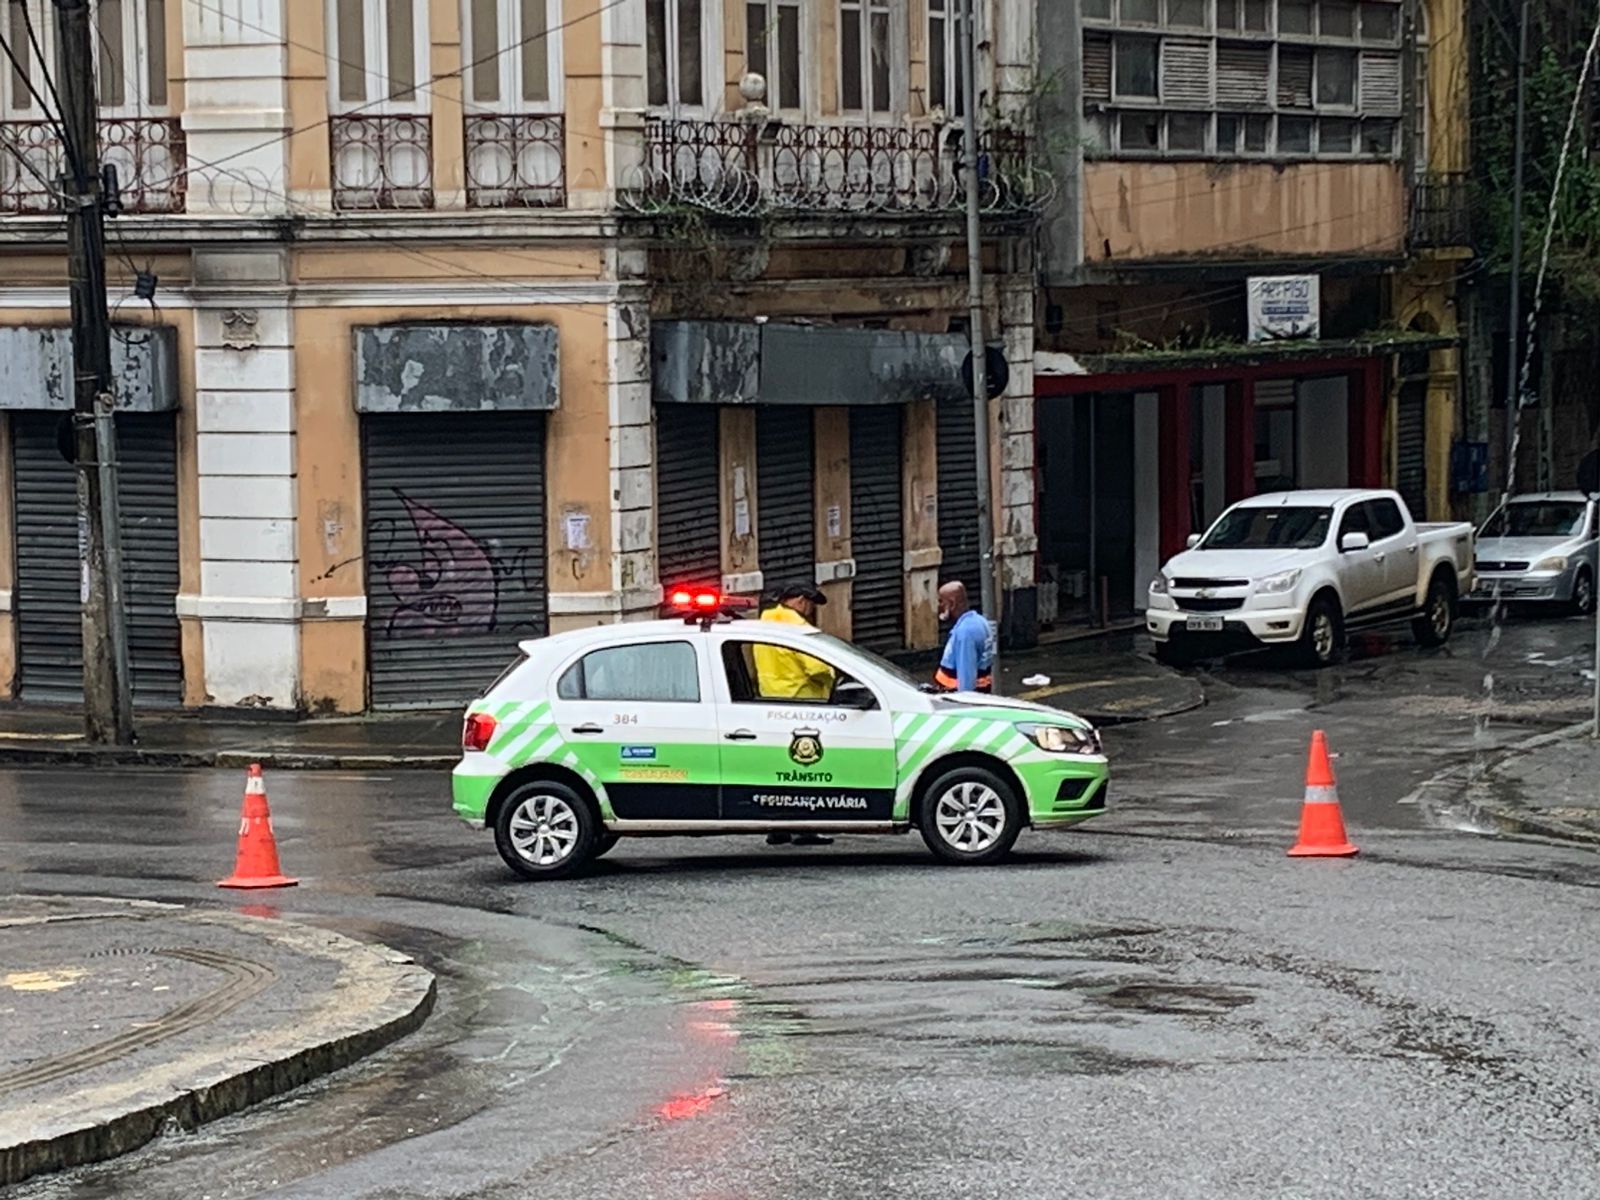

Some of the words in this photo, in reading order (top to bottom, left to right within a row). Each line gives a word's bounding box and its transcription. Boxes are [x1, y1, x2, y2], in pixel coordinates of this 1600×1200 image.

[766, 710, 848, 724] FISCALIZAÇÃO
[775, 769, 833, 783] TRÂNSITO
[825, 793, 868, 809] VIÁRIA
